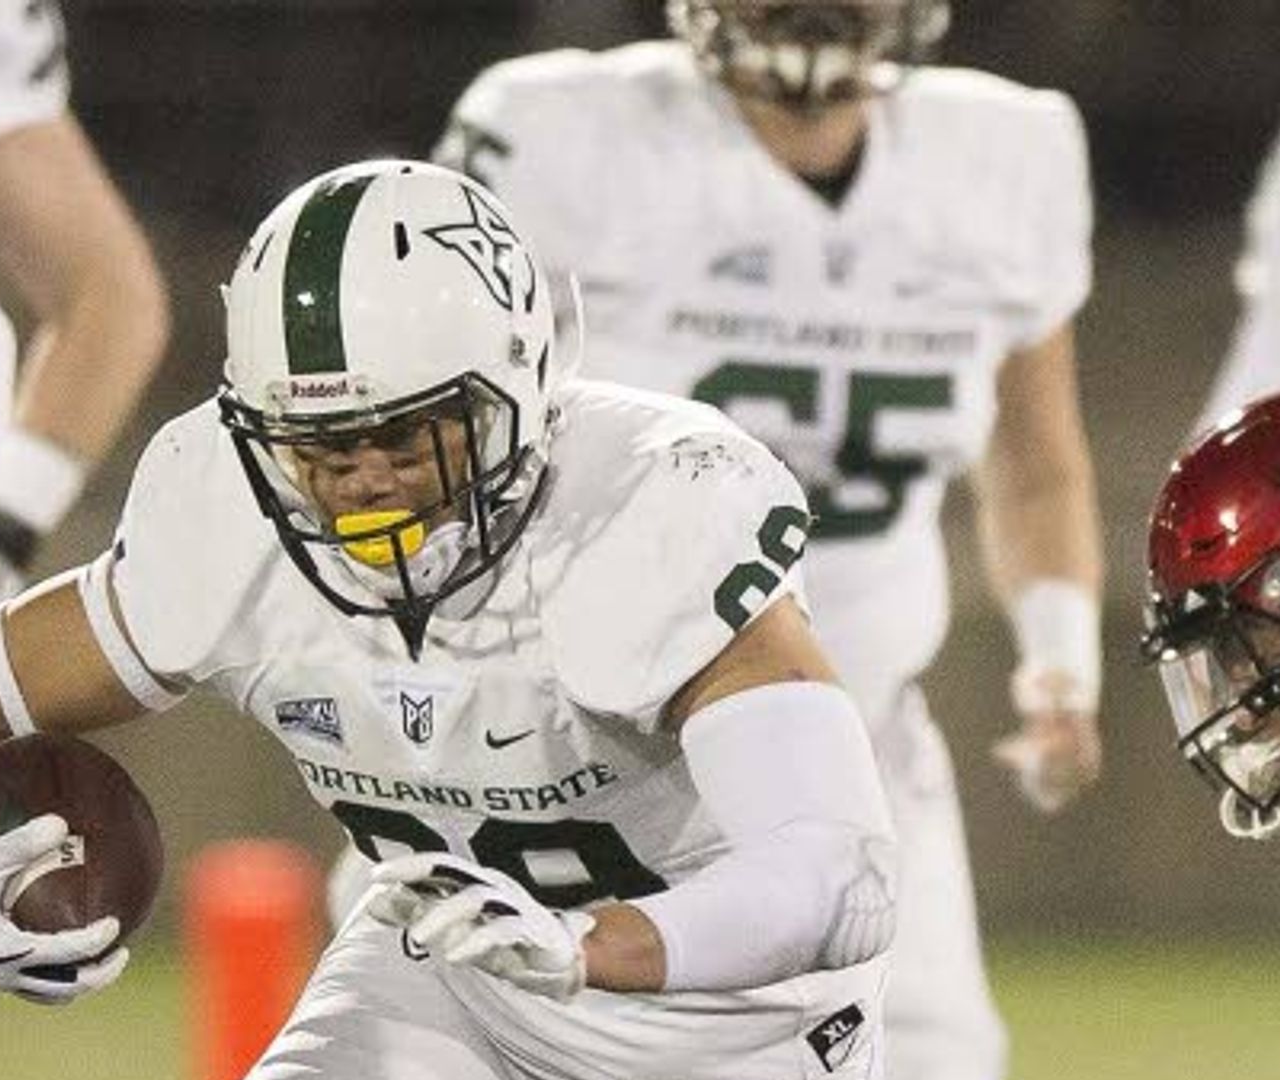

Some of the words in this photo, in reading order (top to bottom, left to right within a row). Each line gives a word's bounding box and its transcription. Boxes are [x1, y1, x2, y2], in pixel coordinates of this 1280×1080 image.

[296, 758, 473, 809] ORTLAND
[483, 763, 619, 812] STATE
[822, 1020, 854, 1045] XL
